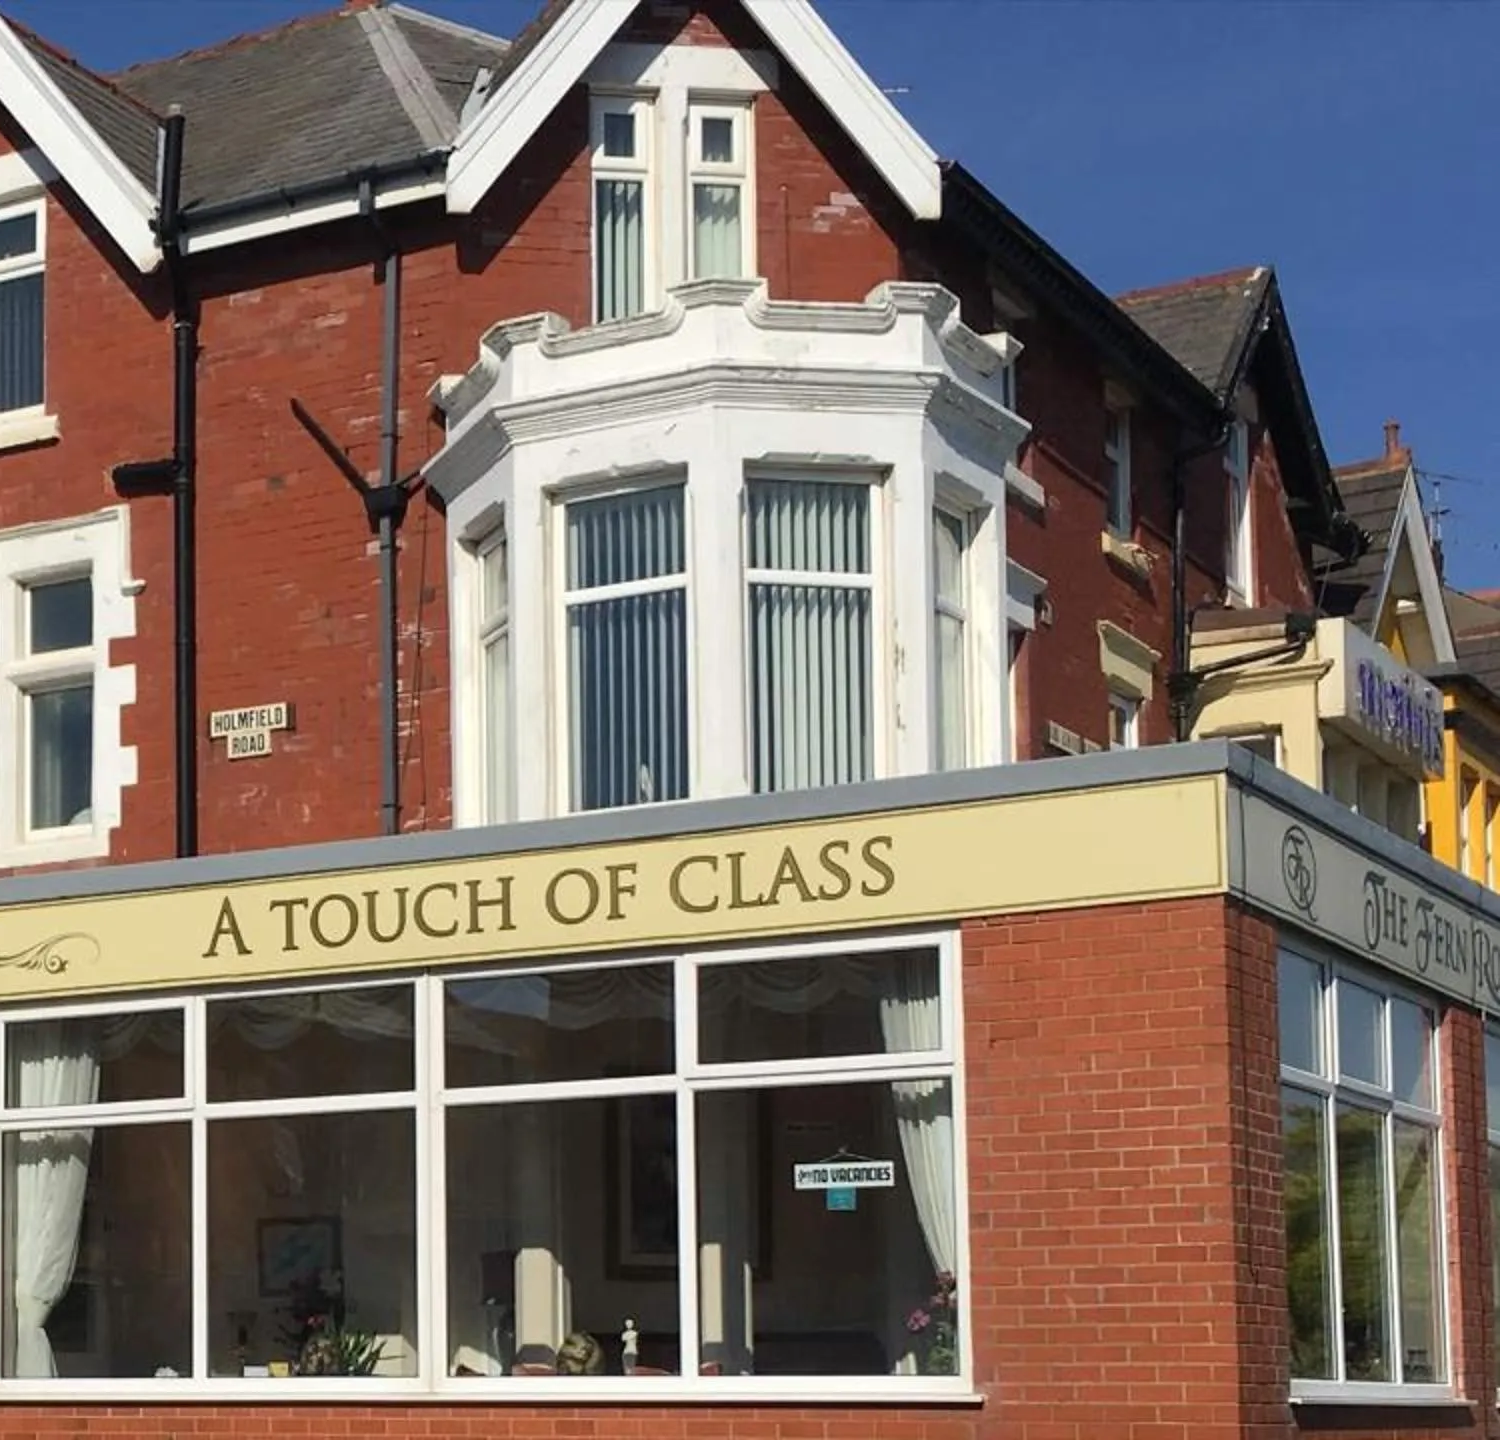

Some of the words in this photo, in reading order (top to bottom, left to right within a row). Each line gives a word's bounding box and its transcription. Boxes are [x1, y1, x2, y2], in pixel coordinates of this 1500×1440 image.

[213, 706, 284, 733] HOLMFIELD
[231, 733, 265, 754] ROAD
[202, 896, 251, 958] A
[269, 876, 517, 952] TOUCH
[544, 863, 638, 926] OF
[668, 835, 896, 915] CLASS
[1363, 870, 1409, 950] THE
[1415, 897, 1468, 973] FERN
[813, 1168, 829, 1183] NO
[831, 1167, 890, 1182] VACANCIES
